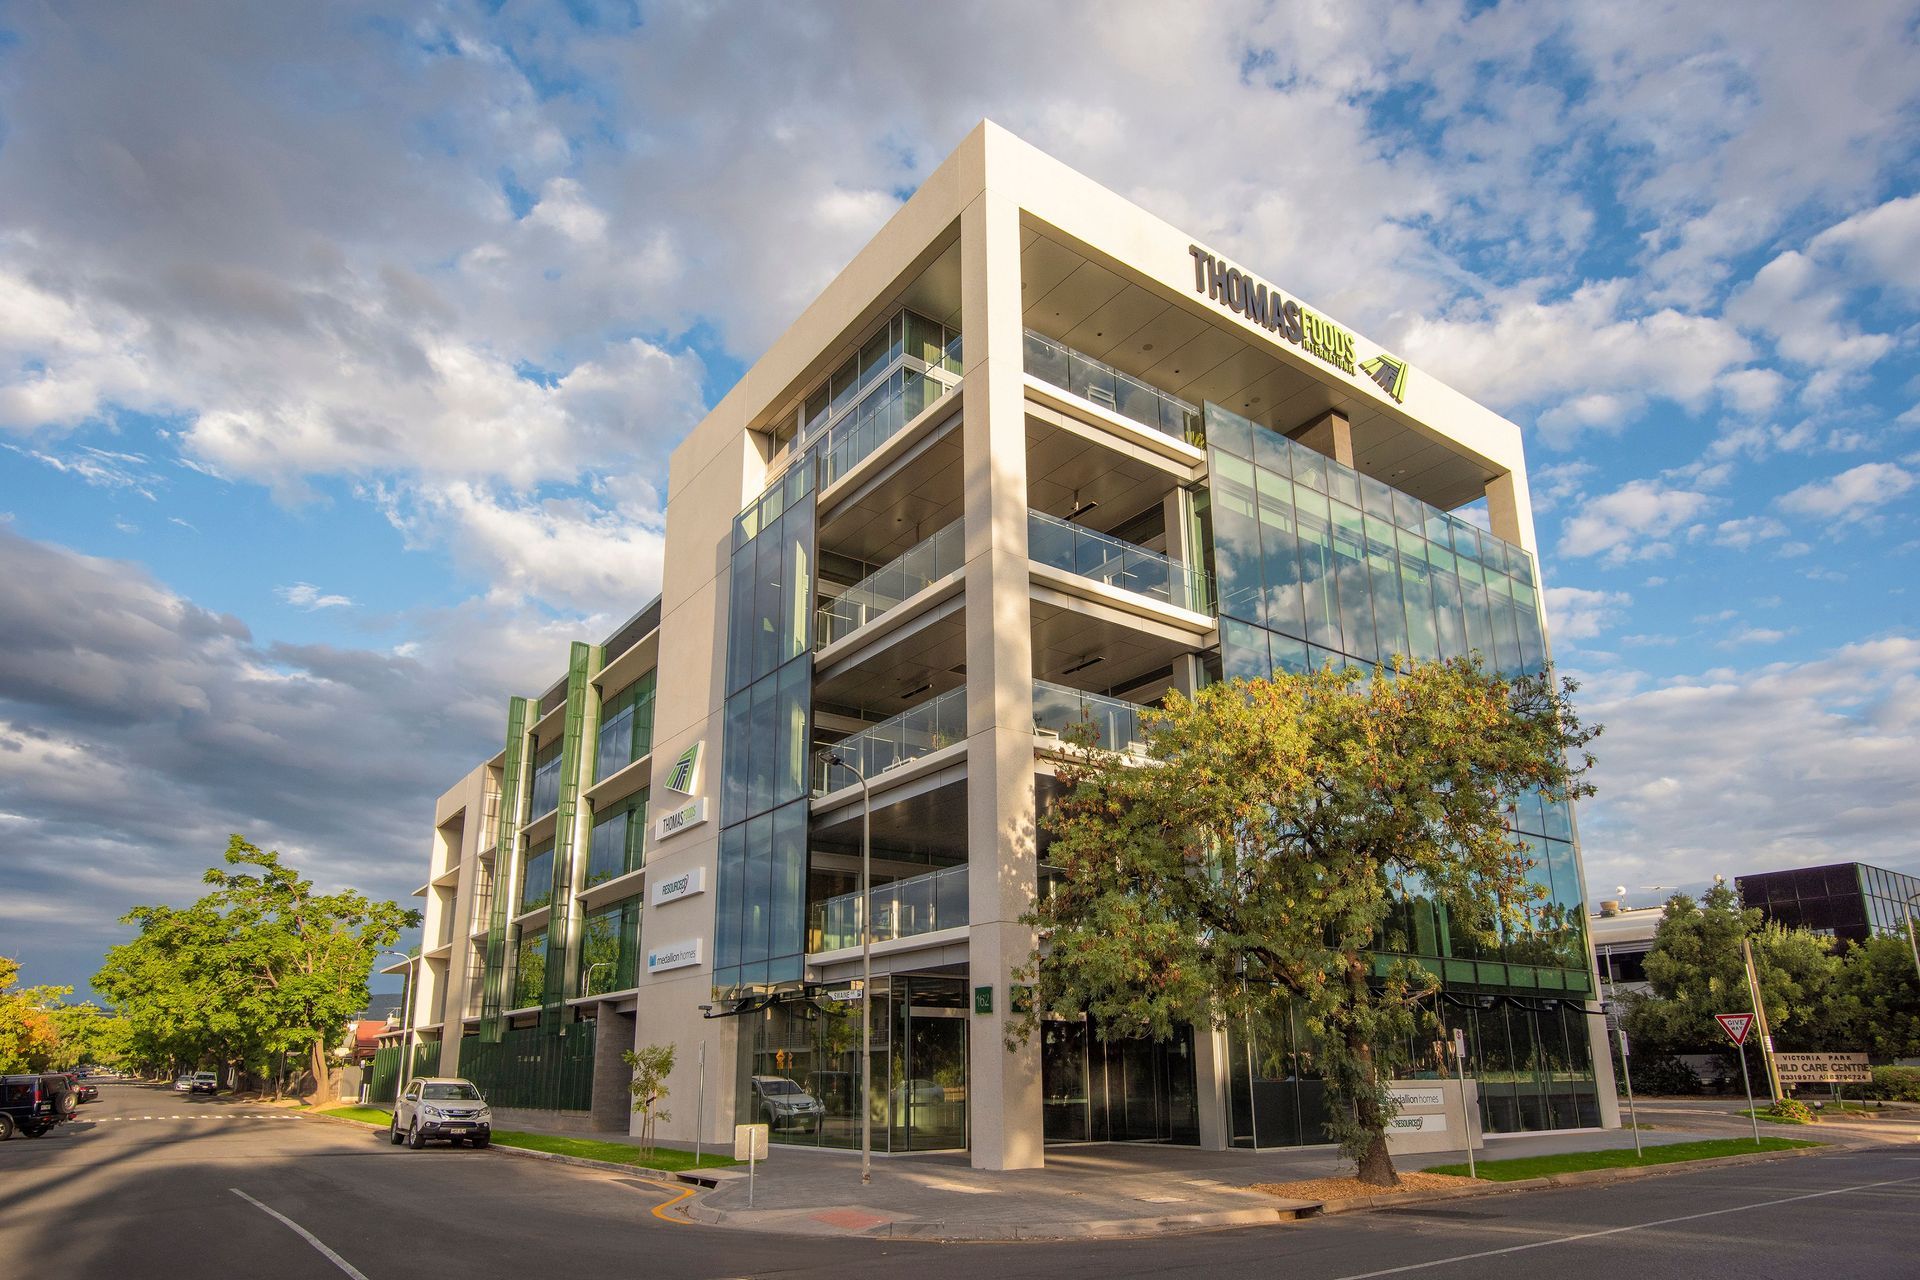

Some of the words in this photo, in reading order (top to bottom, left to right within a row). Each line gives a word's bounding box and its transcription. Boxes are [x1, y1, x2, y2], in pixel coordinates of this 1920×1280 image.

[1188, 244, 1302, 344] THOMAS
[1300, 307, 1357, 363] FOODS
[663, 810, 684, 833] THOMAS
[657, 952, 679, 965] medallion
[680, 949, 696, 961] homes
[976, 994, 989, 1007] 162
[1776, 1063, 1799, 1072] HILD
[1801, 1063, 1828, 1072] CARE
[1830, 1063, 1870, 1072] CENTRE
[1419, 1094, 1439, 1103] homes
